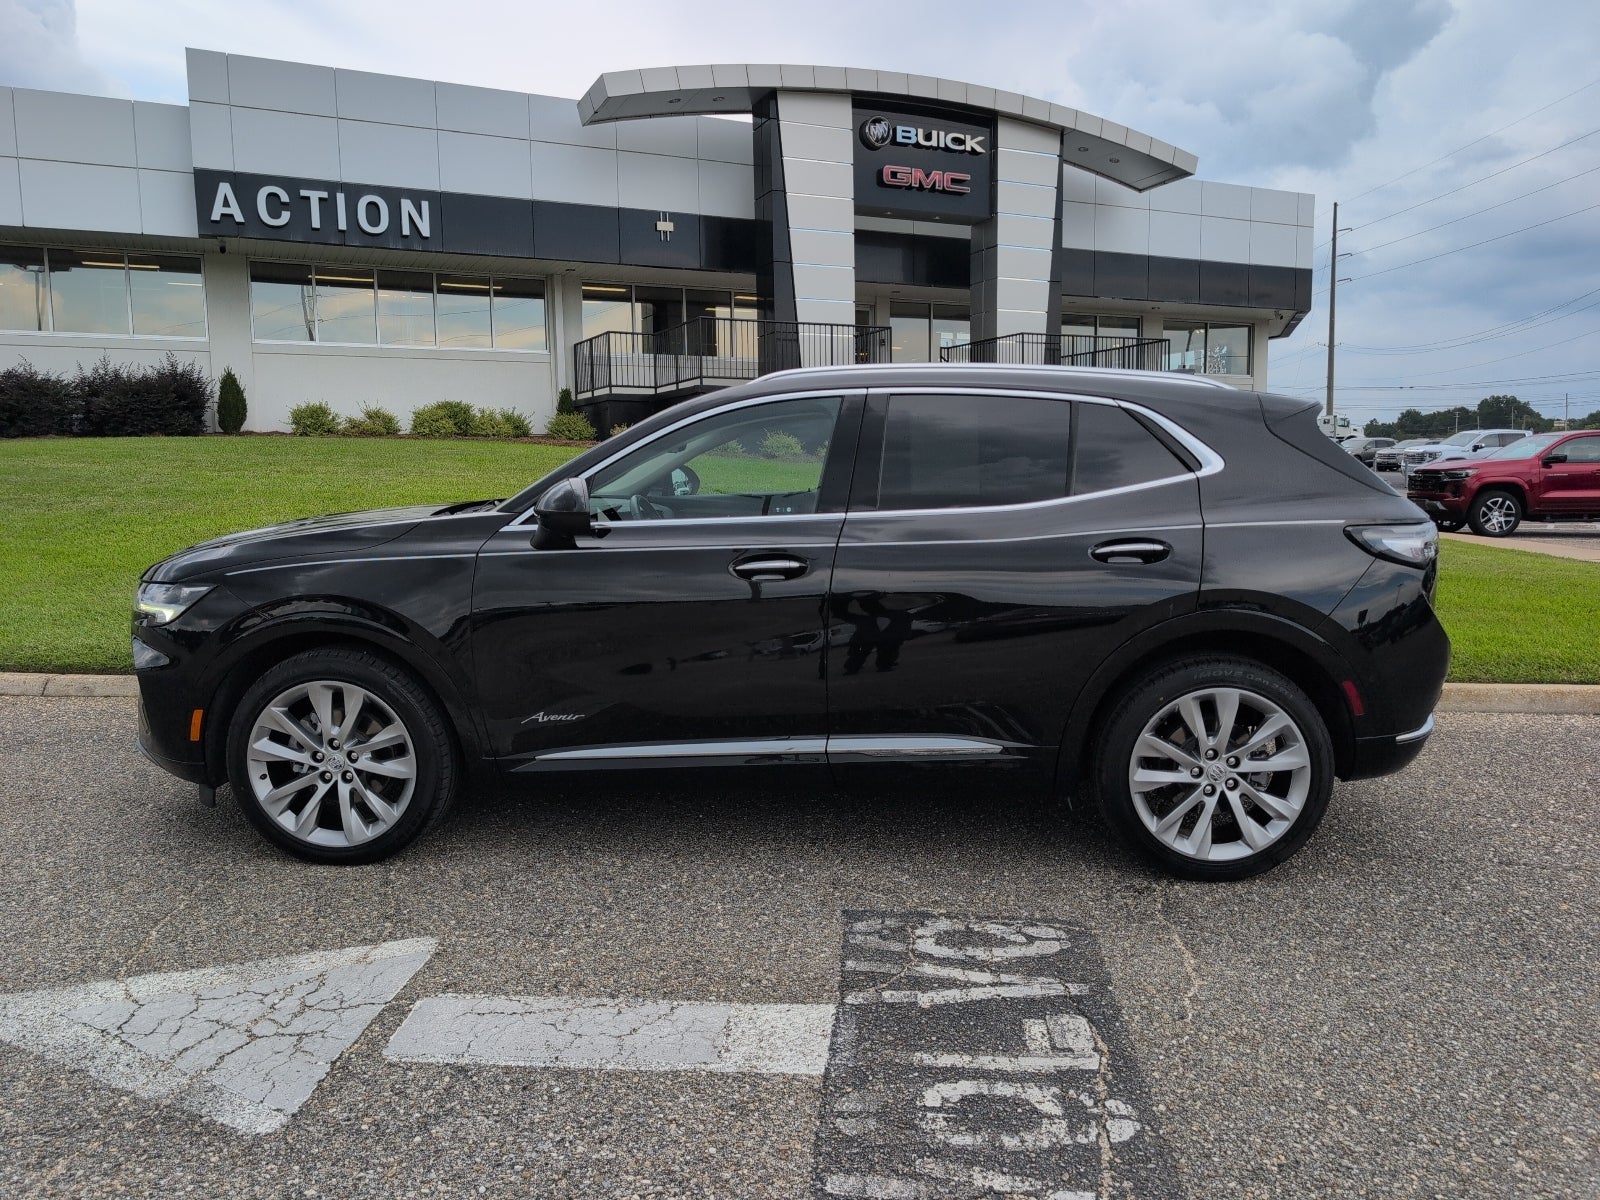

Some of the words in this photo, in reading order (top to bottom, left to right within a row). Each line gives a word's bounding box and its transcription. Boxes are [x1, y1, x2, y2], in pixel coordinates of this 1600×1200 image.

[896, 125, 986, 153] BUICK
[883, 165, 971, 193] GMC
[211, 182, 430, 238] ACTION
[521, 711, 586, 724] Avenir
